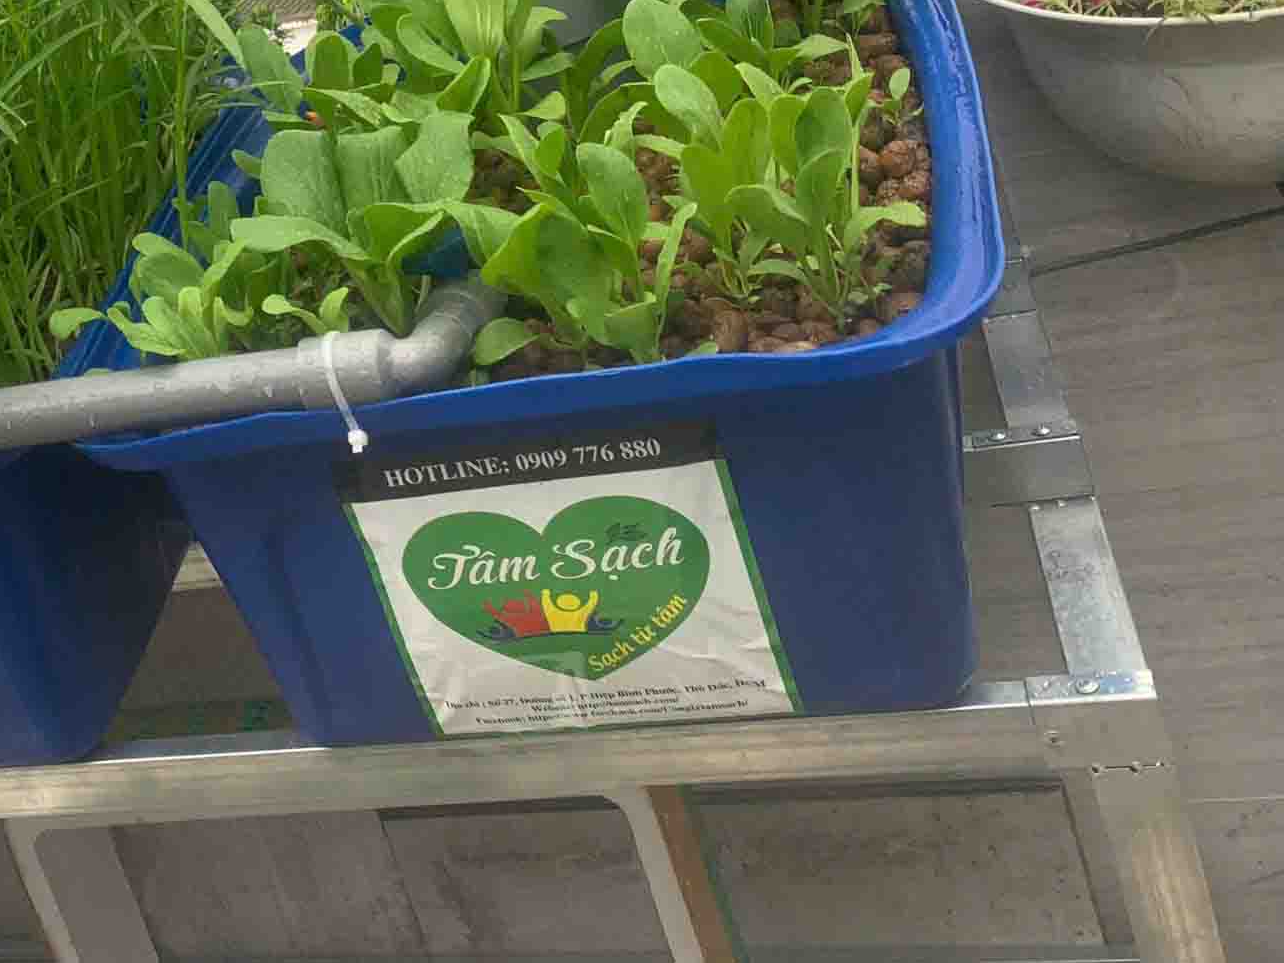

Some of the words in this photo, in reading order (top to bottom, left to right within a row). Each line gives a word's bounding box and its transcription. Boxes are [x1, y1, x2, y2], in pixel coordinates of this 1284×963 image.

[384, 455, 511, 487] HOTLINE:
[515, 448, 567, 471] 0909
[571, 443, 615, 465] 776
[619, 436, 661, 460] 880
[427, 544, 541, 590] Tâm
[549, 527, 685, 581] Sạch
